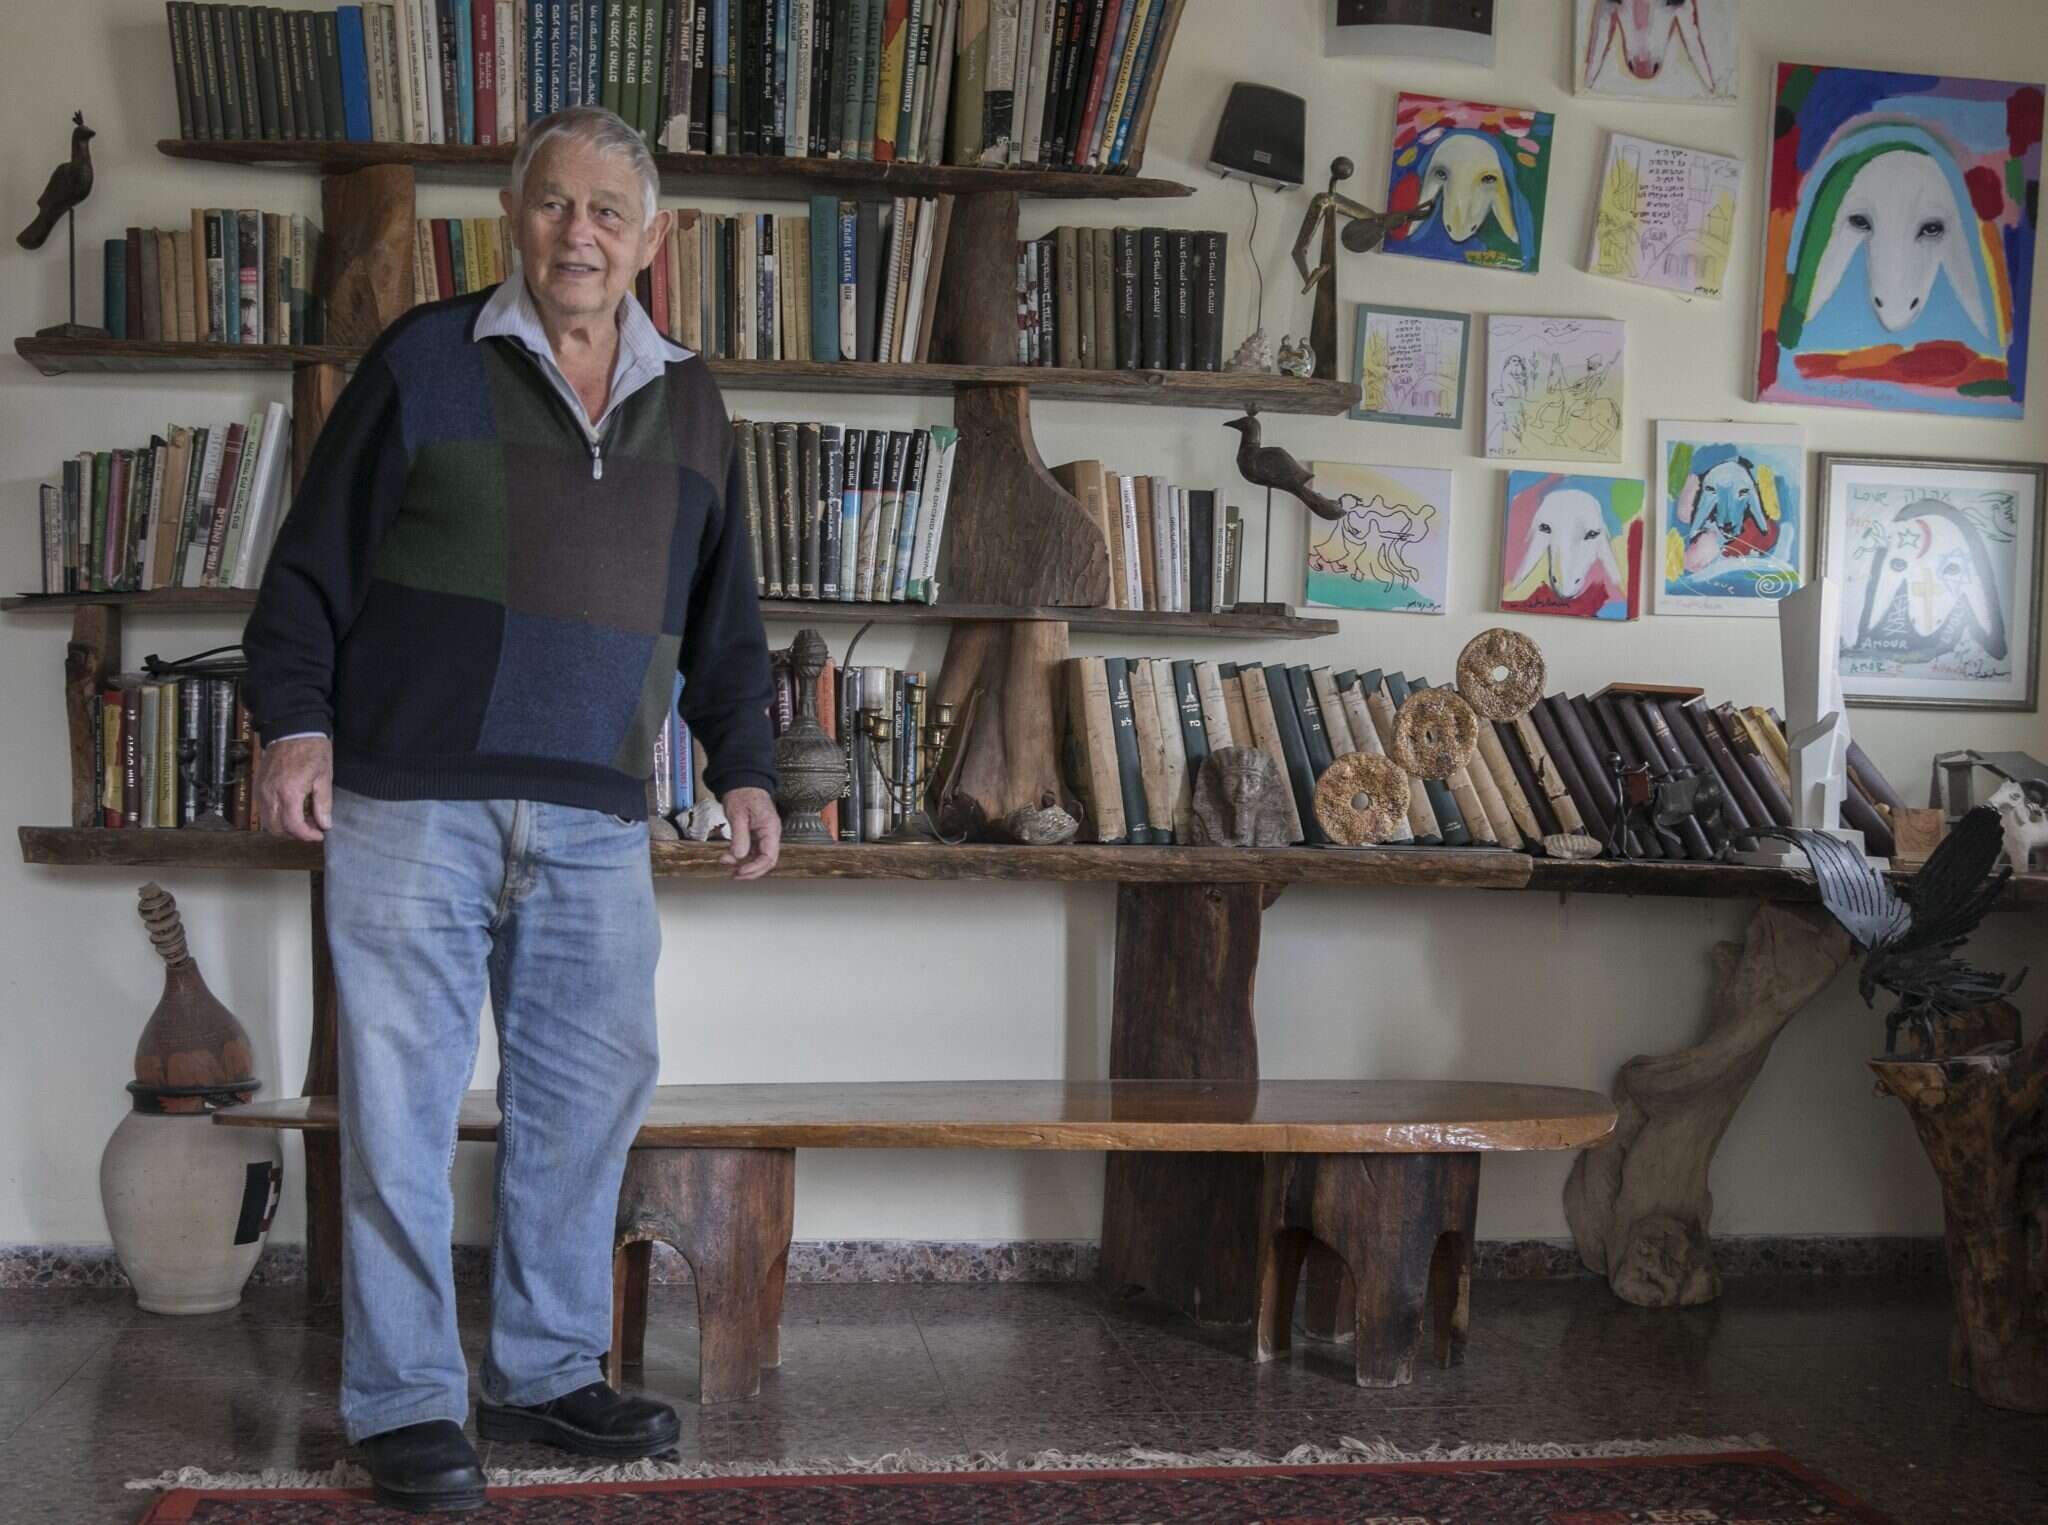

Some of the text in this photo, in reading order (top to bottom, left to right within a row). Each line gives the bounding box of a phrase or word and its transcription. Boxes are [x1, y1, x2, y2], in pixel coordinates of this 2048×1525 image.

[536, 3, 544, 24] מסע
[552, 4, 560, 25] מסע
[533, 27, 543, 39] אל
[549, 28, 560, 40] אל
[608, 4, 620, 82] אל הסלע האדום
[626, 5, 639, 84] אל הסלע האדום
[919, 28, 929, 45] ארץ
[535, 41, 545, 66] הירדן
[552, 42, 561, 67] הירדן
[693, 33, 705, 68] ואתרים
[211, 508, 227, 544] ואתרים
